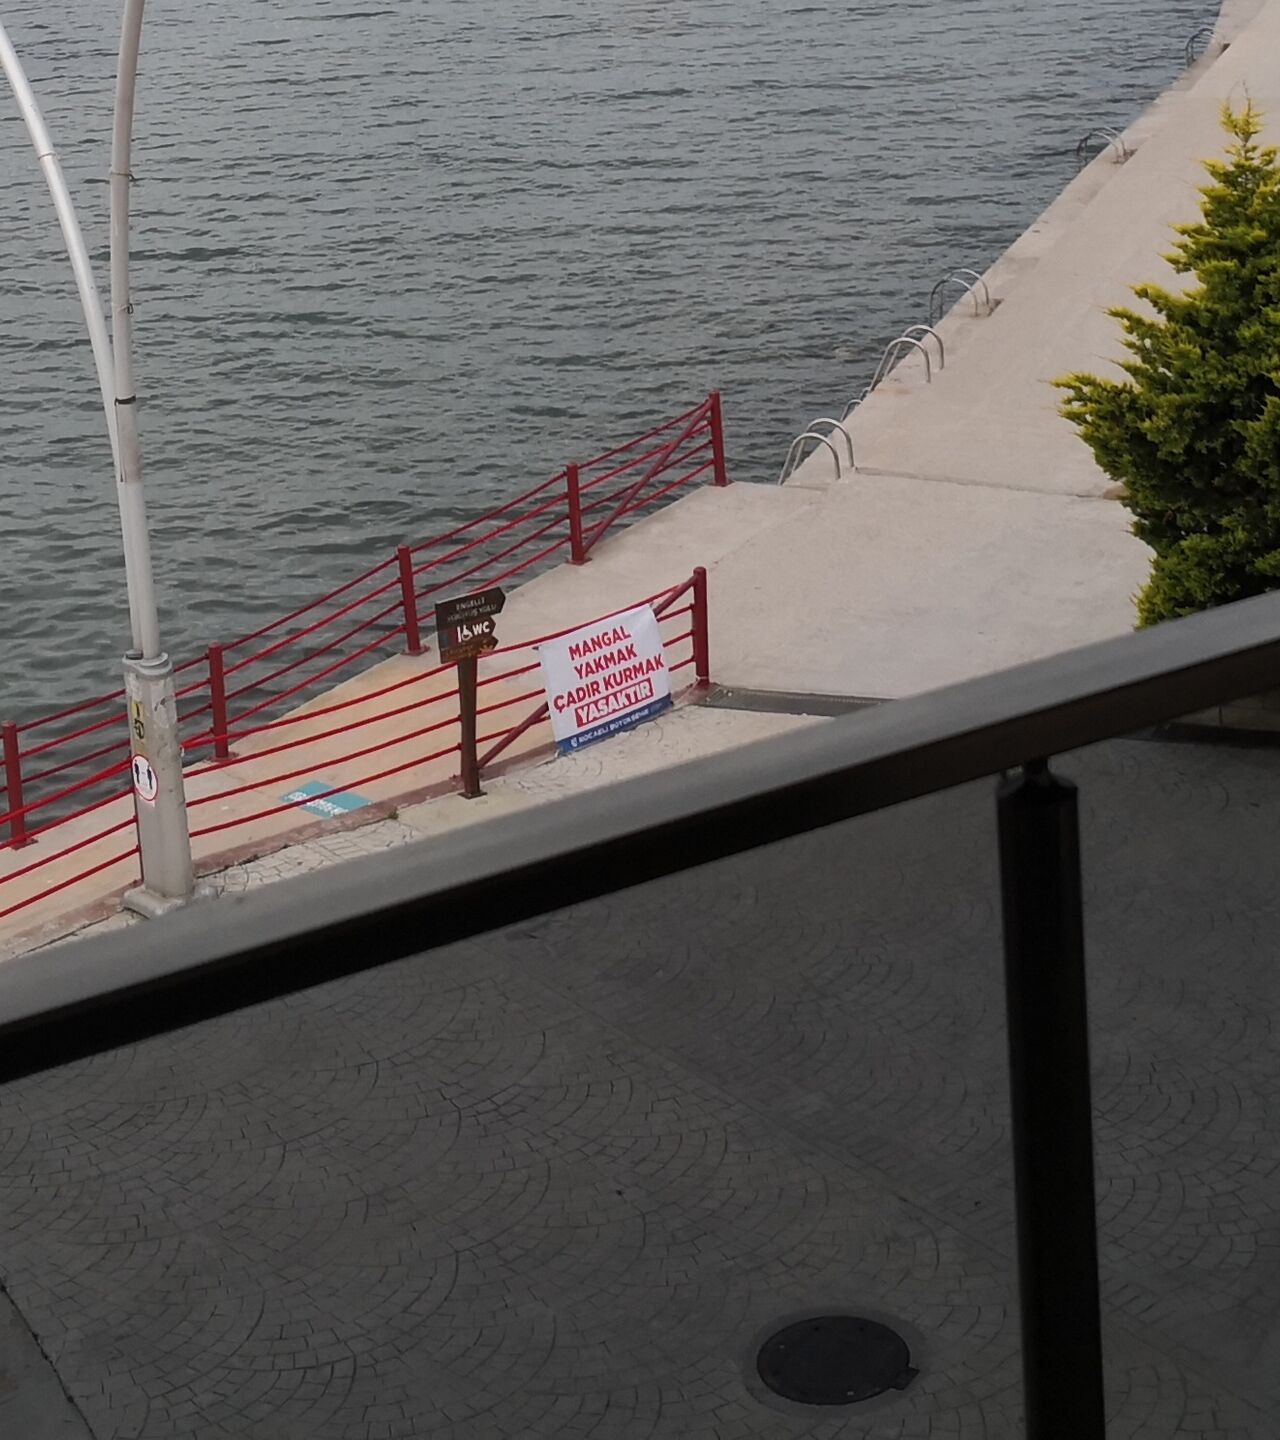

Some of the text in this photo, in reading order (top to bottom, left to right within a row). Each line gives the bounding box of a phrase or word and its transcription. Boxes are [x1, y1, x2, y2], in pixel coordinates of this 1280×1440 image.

[472, 621, 490, 636] WC
[568, 625, 632, 662] MANGAL
[574, 643, 637, 680] YAKMAK
[554, 654, 664, 714] ÇADIR KURMAK
[576, 680, 651, 723] YASAKTIR
